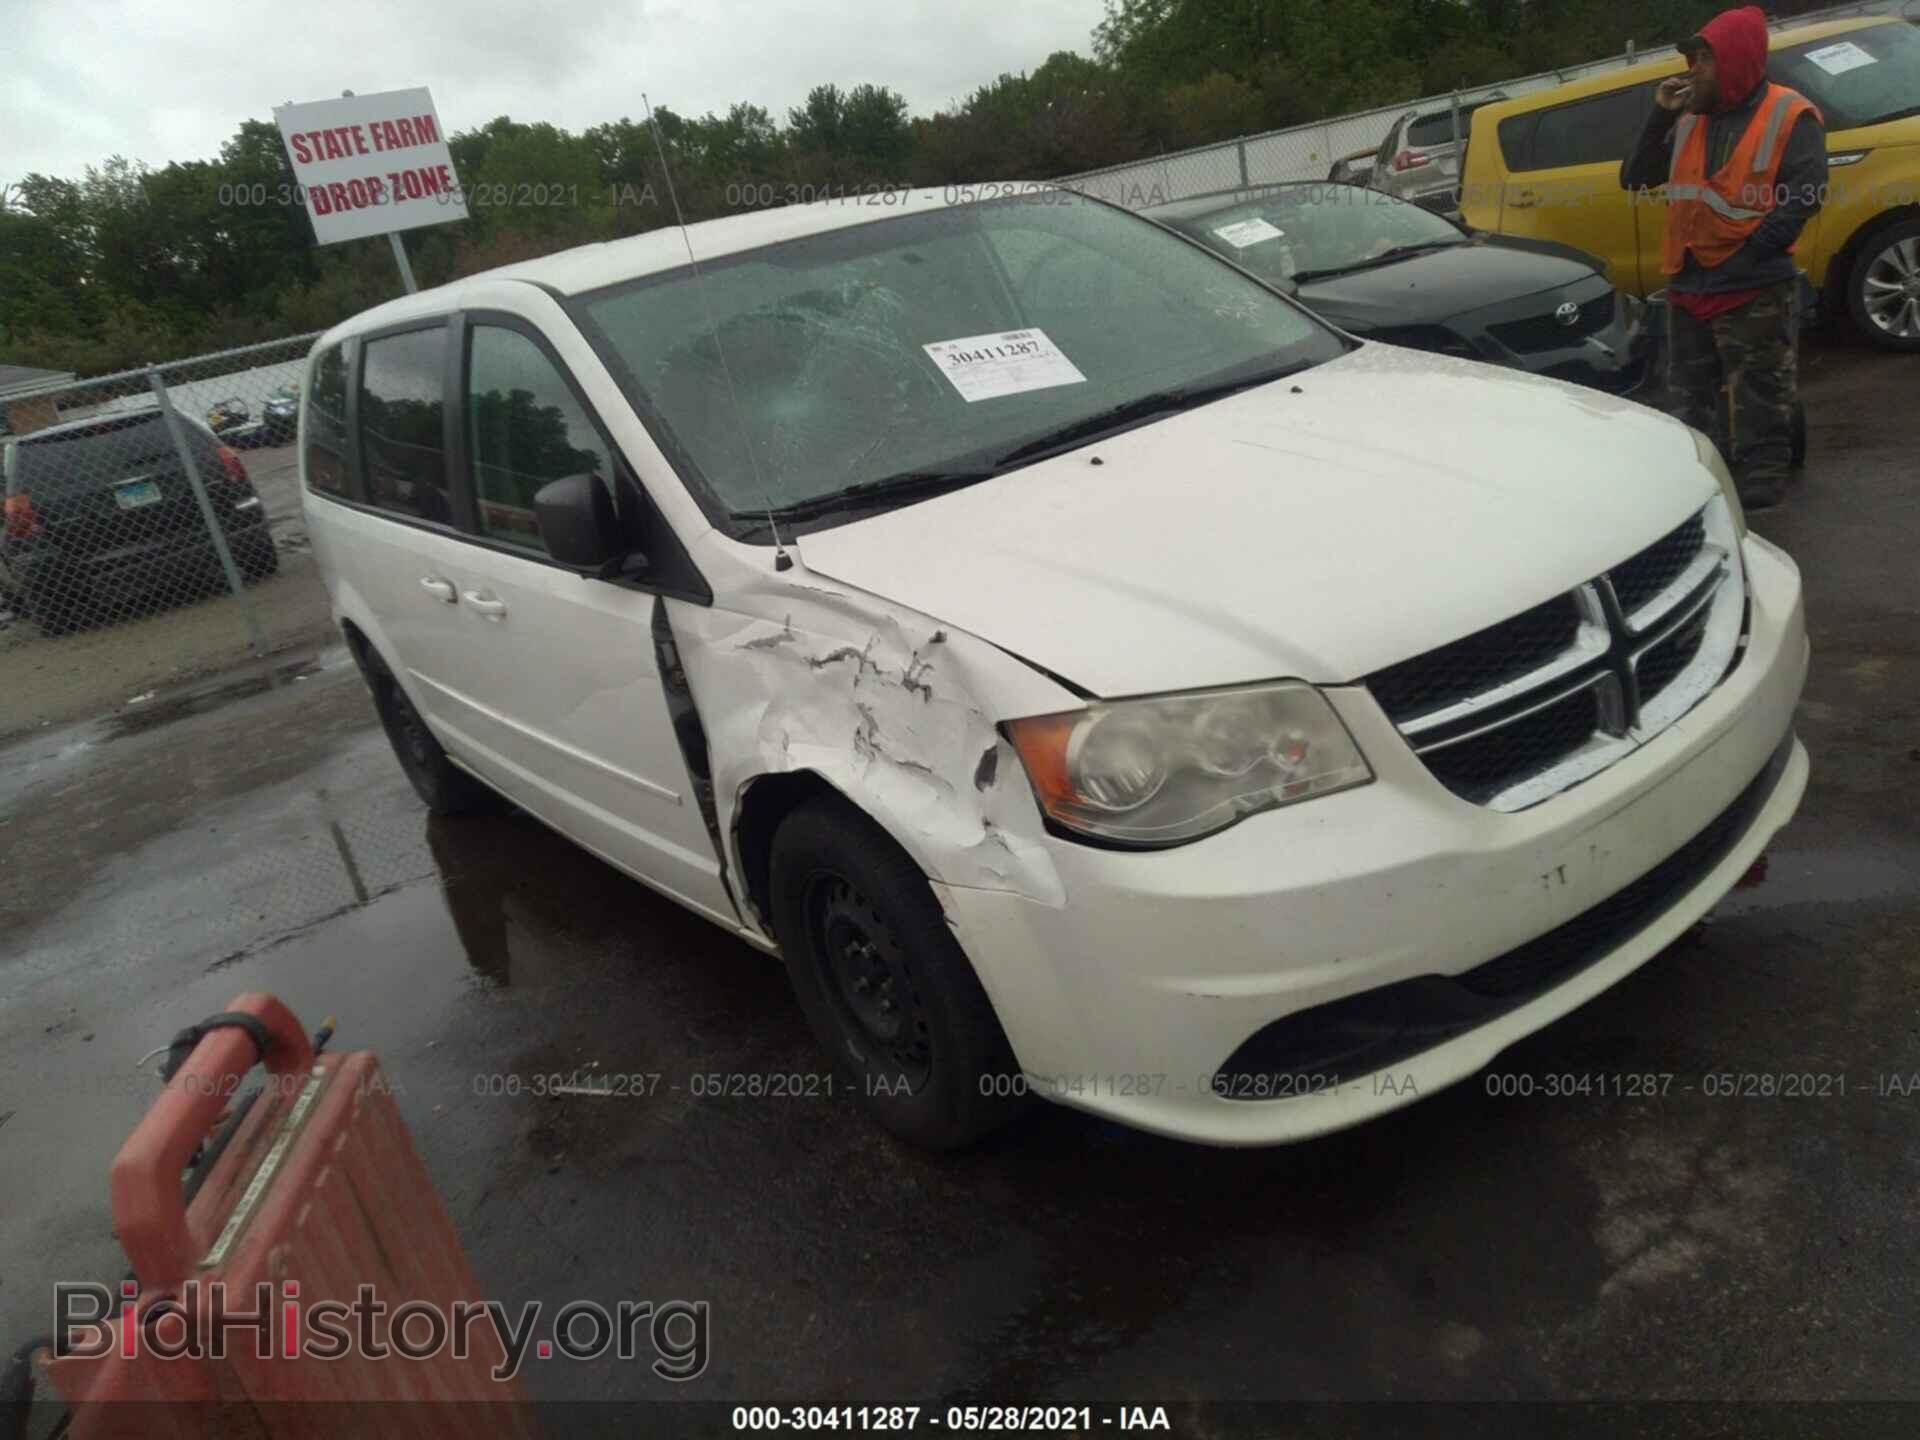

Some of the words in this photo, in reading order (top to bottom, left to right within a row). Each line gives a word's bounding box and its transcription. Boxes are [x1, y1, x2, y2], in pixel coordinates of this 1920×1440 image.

[290, 125, 371, 165] STATE
[368, 114, 440, 153] FARM
[308, 176, 385, 217] DROP
[386, 164, 454, 203] ZONE
[947, 340, 1040, 366] 30411287
